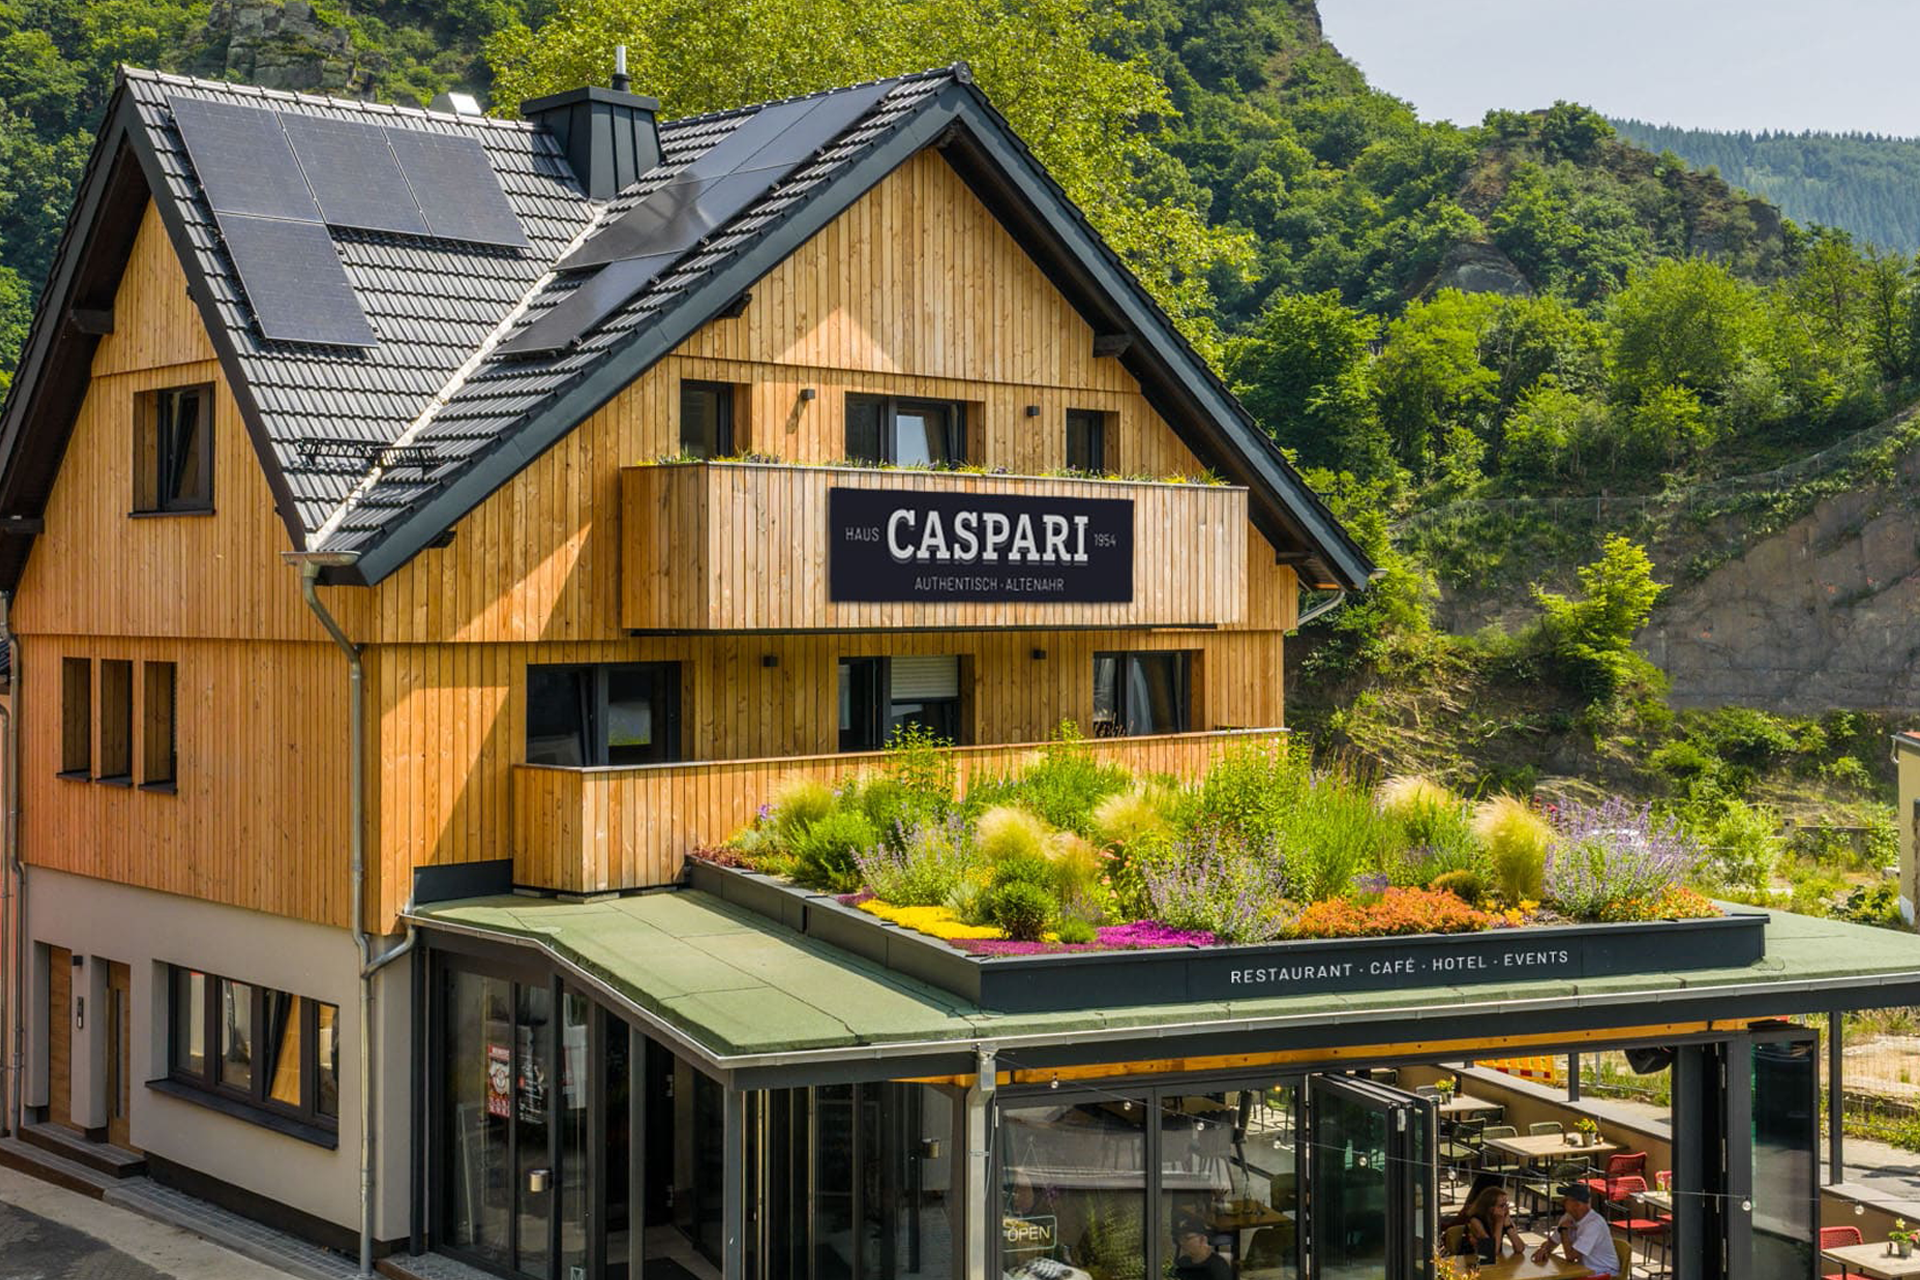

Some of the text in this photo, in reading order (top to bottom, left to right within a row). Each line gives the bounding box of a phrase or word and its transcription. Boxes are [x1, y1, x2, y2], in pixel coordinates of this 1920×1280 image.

[845, 508, 1117, 564] HAUS CASPARI 1954
[914, 576, 1065, 592] AUTHENTISCH ALTENAHR
[1230, 950, 1569, 984] RESTAURANT CAFÉ HOTEL EVENTS
[1008, 1226, 1051, 1242] OPEN
